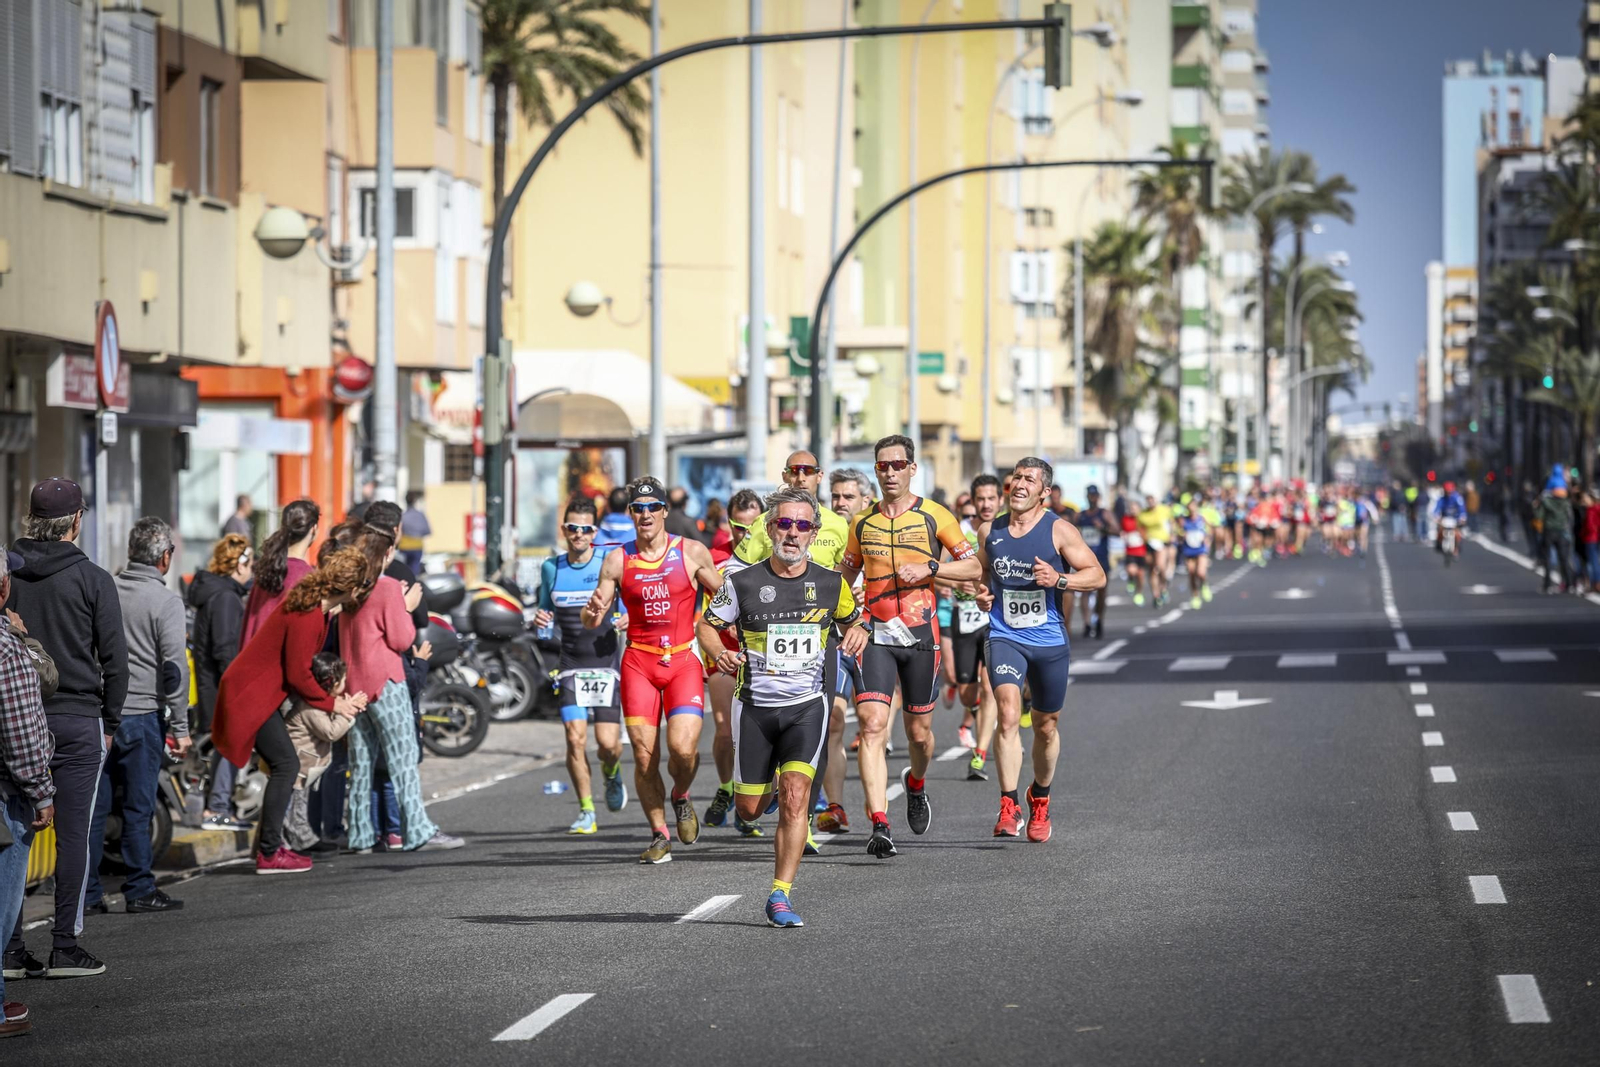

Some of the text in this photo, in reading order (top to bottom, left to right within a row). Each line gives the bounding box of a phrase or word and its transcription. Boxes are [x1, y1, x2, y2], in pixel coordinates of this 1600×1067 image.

[642, 582, 670, 601] OCAÑA
[644, 601, 671, 616] ESP
[1009, 601, 1041, 615] 906
[774, 638, 811, 654] 611
[581, 681, 609, 694] 447
